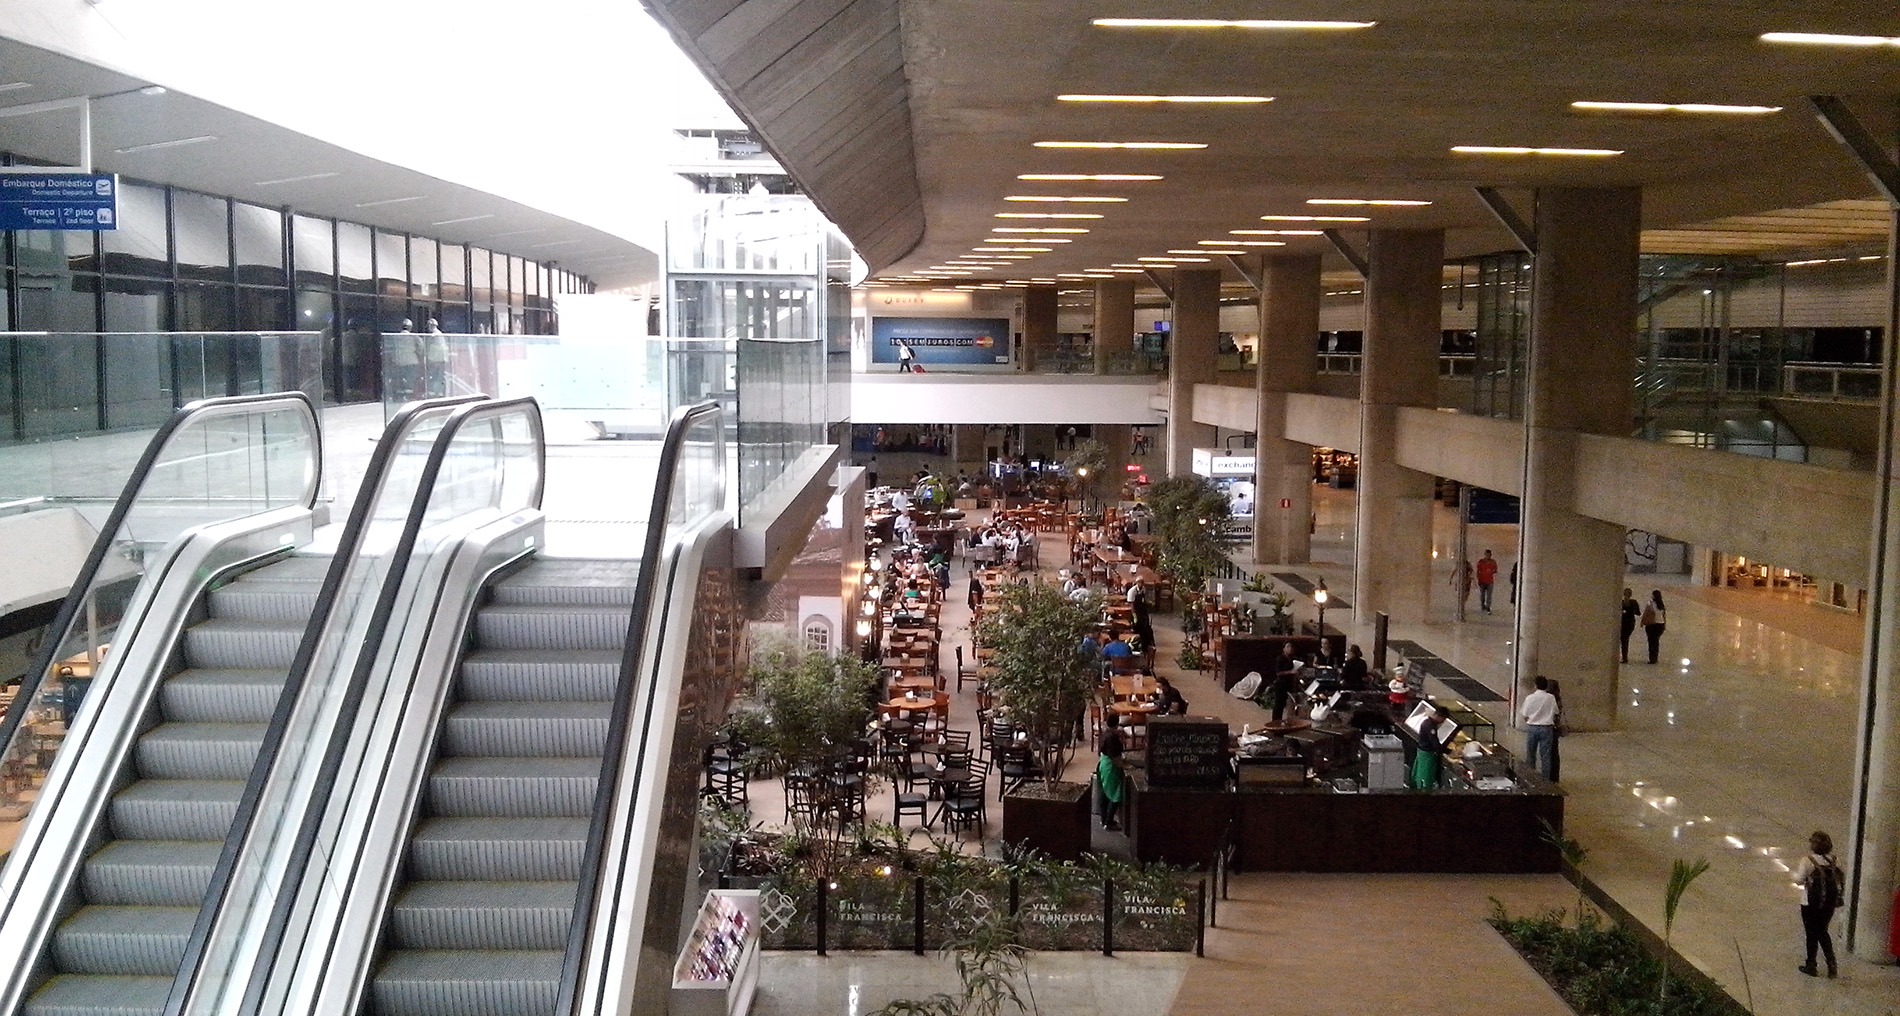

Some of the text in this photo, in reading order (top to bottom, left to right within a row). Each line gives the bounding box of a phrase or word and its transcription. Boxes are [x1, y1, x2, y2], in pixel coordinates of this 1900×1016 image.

[2, 179, 46, 189] Embarque
[62, 189, 94, 197] Departure
[22, 208, 55, 218] Terraço
[75, 208, 94, 217] piso
[1226, 524, 1253, 533] camb
[1124, 895, 1149, 904] VILA
[1032, 903, 1057, 911] VILA
[1124, 905, 1186, 915] FRANCISCA
[840, 913, 902, 921] FRANCISCA
[1032, 913, 1094, 922] FRANCISCA
